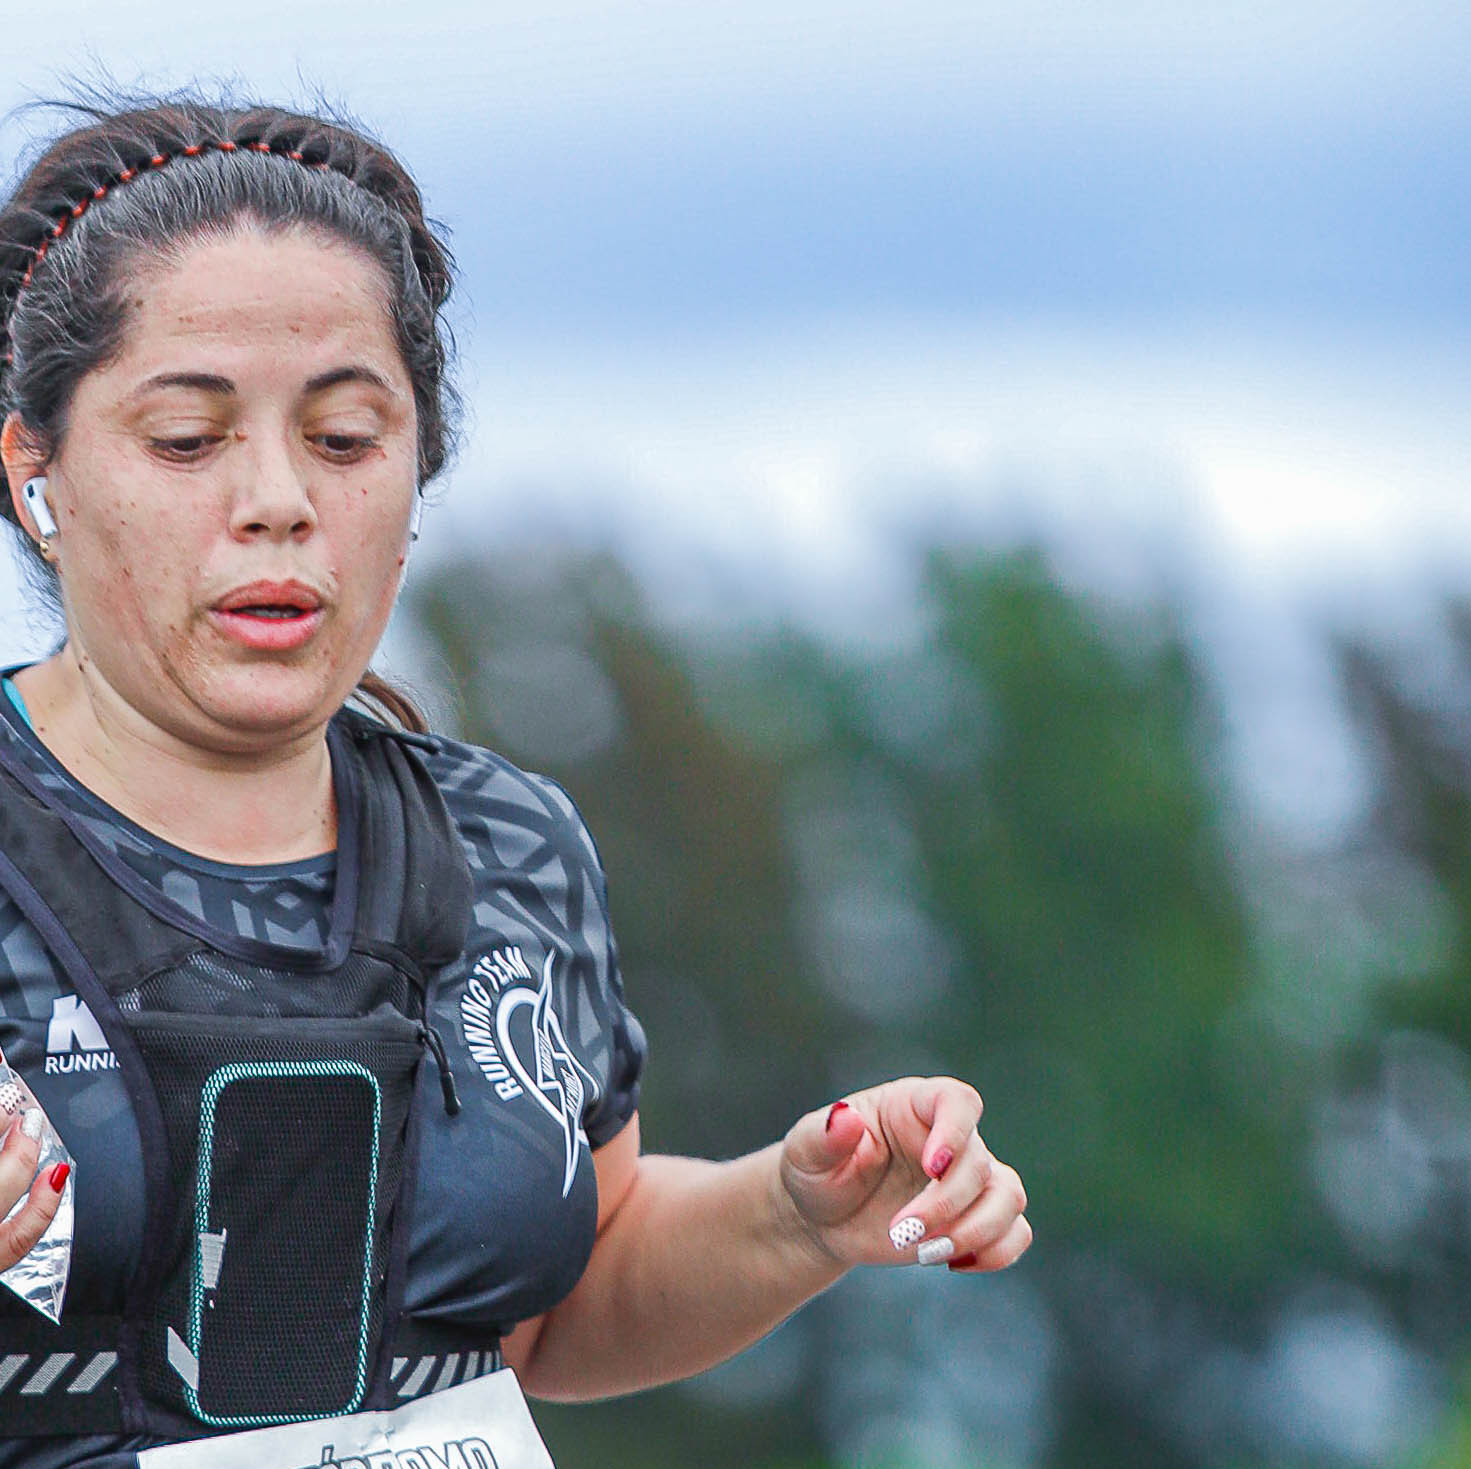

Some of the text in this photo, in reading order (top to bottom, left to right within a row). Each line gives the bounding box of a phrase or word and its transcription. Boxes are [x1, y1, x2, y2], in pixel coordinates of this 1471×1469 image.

[44, 1051, 121, 1075] RUNNI
[460, 945, 532, 1101] RUNNING TEAM
